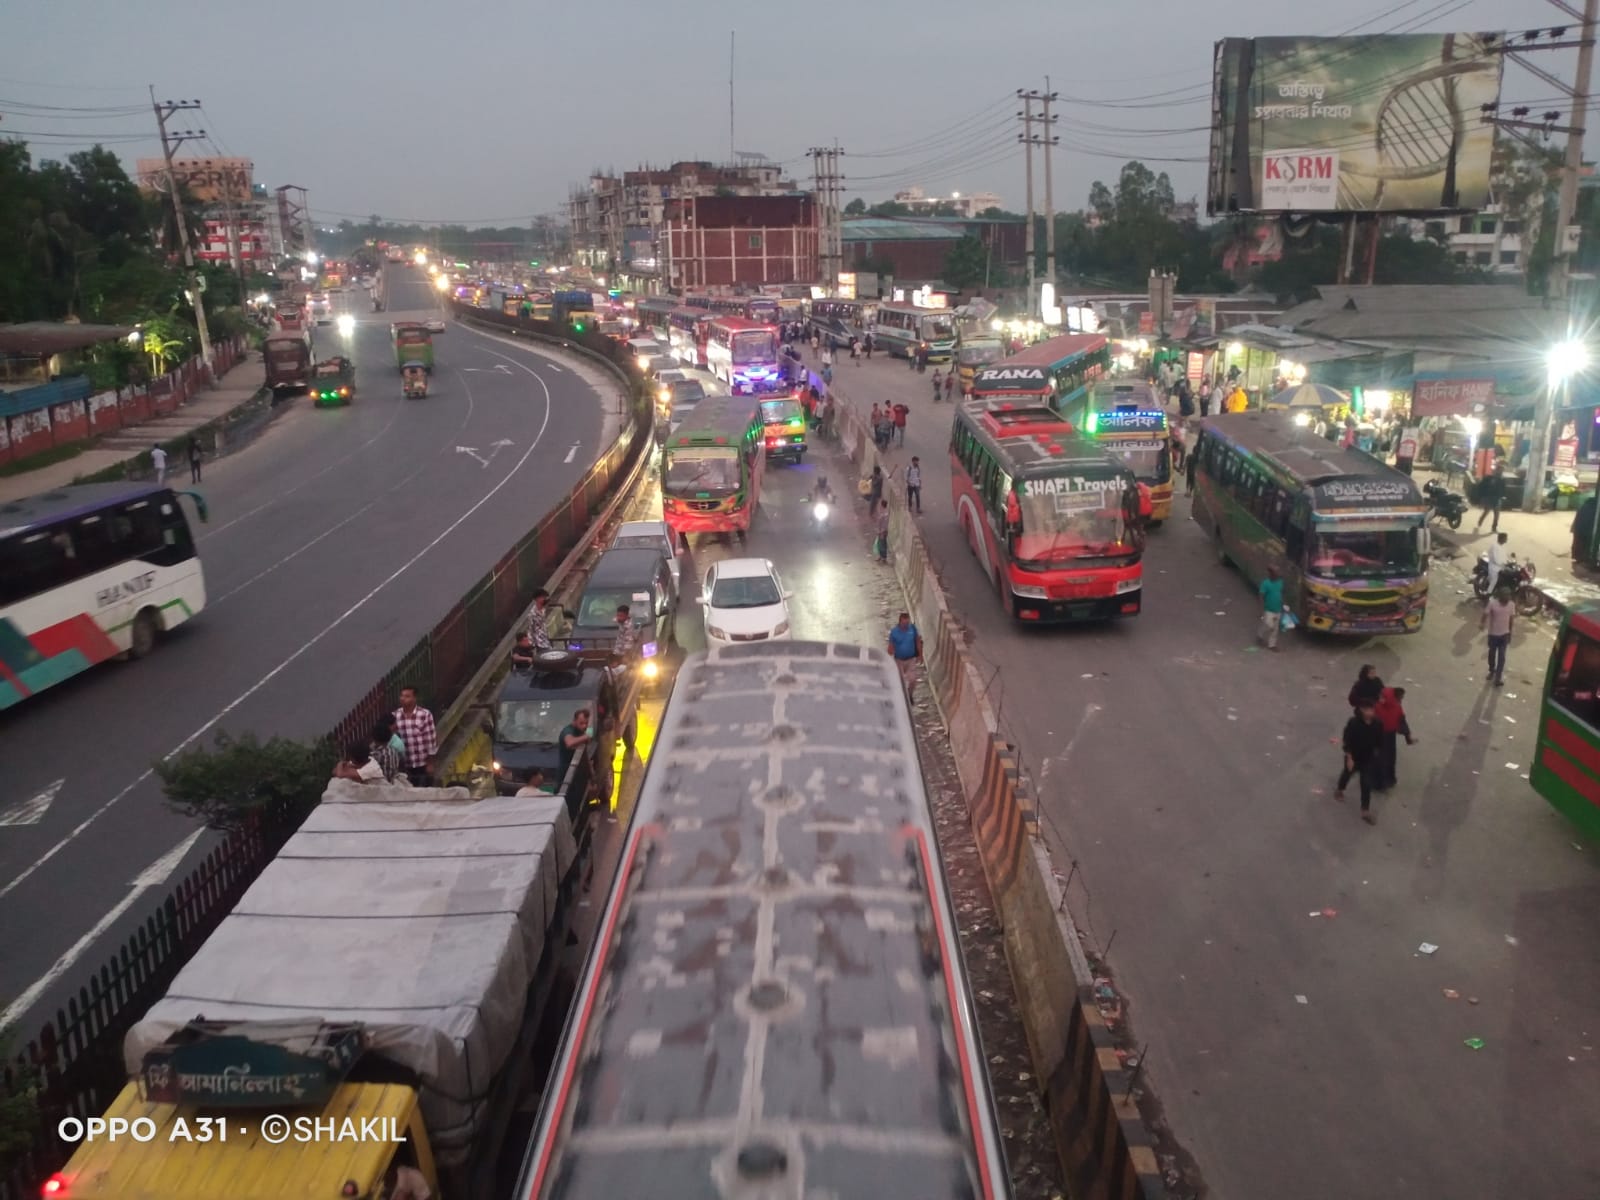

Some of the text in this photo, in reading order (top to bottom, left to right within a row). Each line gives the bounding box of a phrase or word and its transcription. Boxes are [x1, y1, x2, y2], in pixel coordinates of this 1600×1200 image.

[1312, 101, 1353, 120] শিখরে
[1265, 156, 1333, 183] KSRM
[981, 368, 1044, 380] RANA
[1098, 415, 1156, 427] আলিফ
[1024, 475, 1128, 497] SHAFI Travels
[96, 570, 156, 608] HANIF
